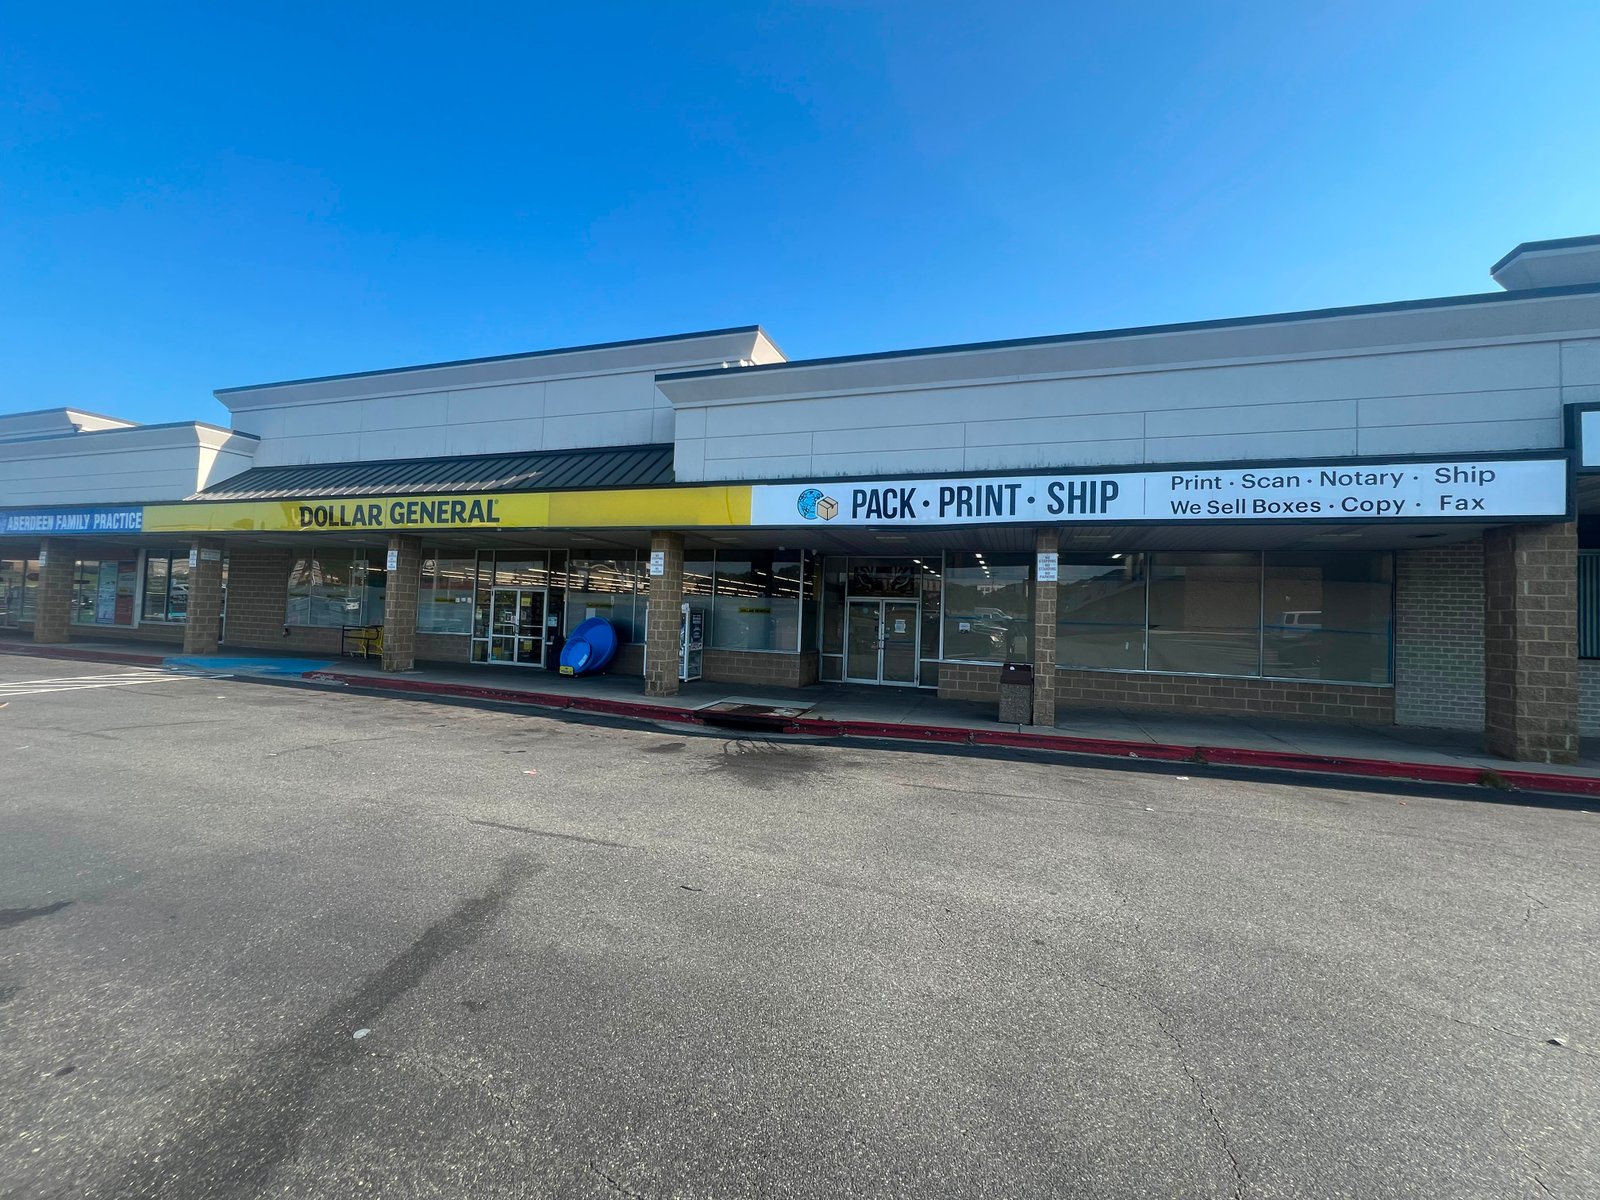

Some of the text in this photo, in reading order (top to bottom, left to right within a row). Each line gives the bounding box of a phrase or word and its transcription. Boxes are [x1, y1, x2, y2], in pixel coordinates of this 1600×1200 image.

[1171, 466, 1496, 491] Print Scan Notary Ship
[851, 480, 1119, 519] PACK PRINT SHIP
[1170, 494, 1485, 515] We Sell Boxes Copy Fax
[6, 512, 142, 531] ABERDEEN FAMILY PRACTICE
[299, 499, 500, 528] DOLLAR GENERAL
